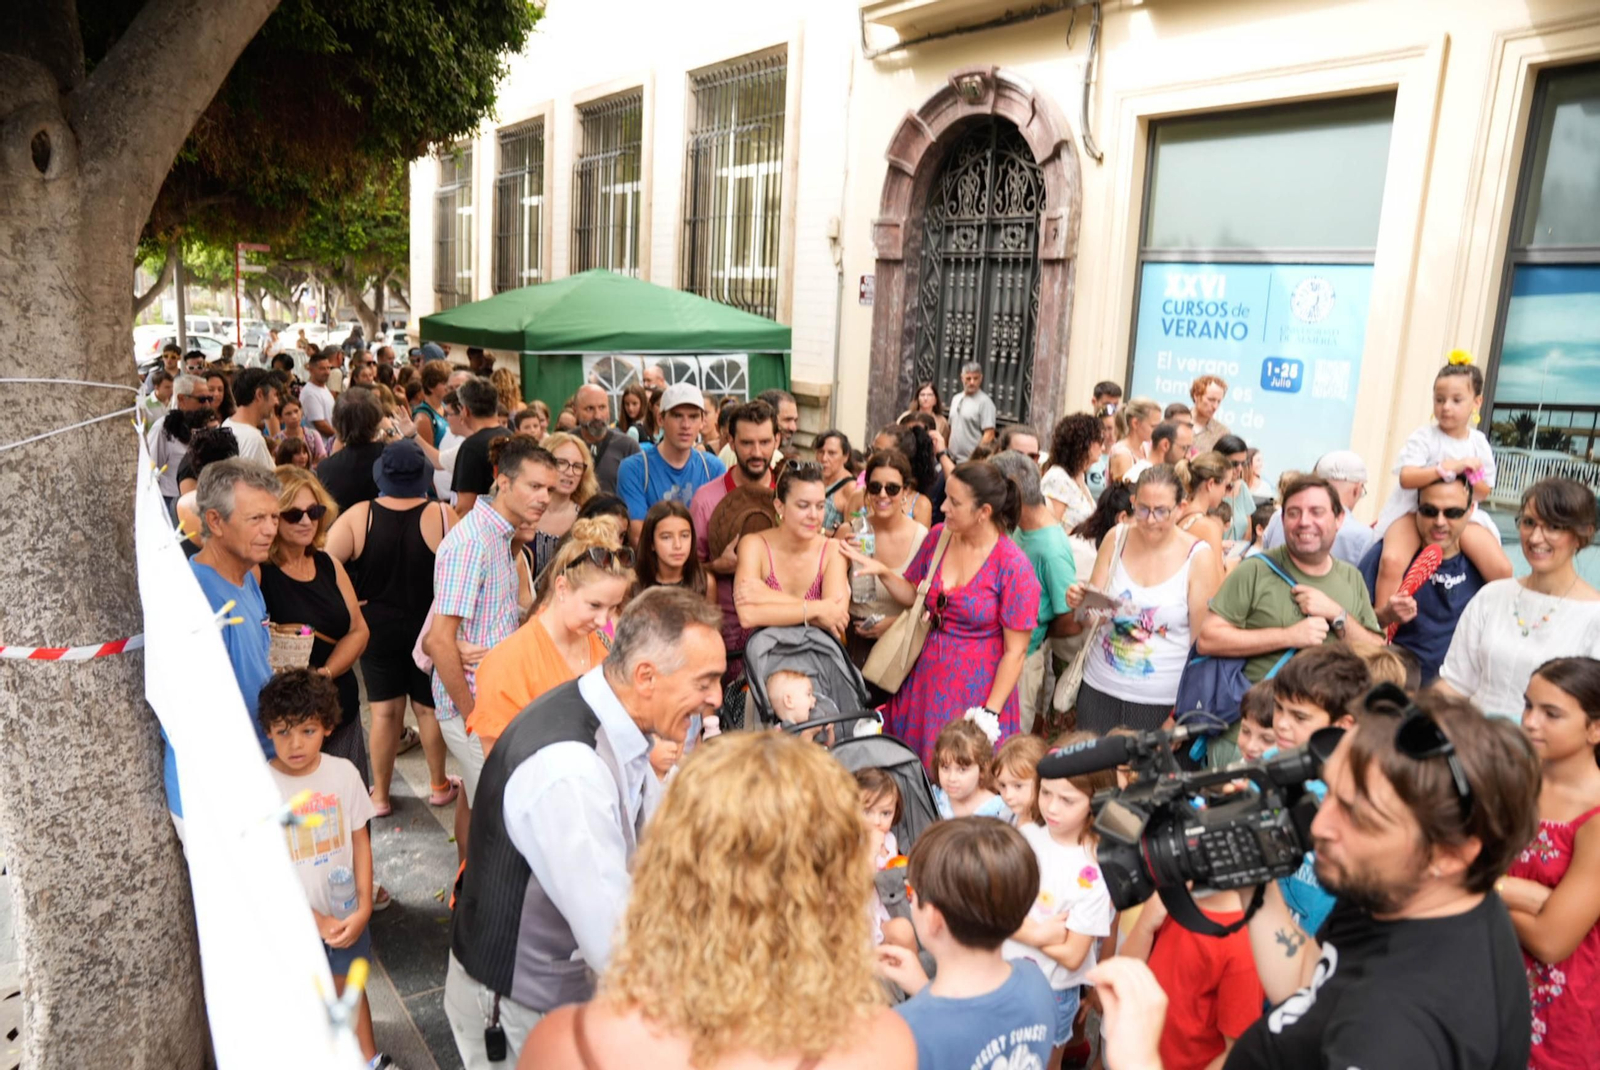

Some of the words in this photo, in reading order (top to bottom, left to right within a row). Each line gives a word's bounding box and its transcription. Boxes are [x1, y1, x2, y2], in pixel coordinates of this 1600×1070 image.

[1164, 274, 1226, 299] XXVI
[1162, 300, 1228, 317] CURSOS
[1231, 302, 1250, 318] de
[1162, 317, 1249, 341] VERANO
[1157, 350, 1172, 370] El
[1177, 357, 1240, 376] verano
[1270, 376, 1292, 389] Julio
[1232, 386, 1253, 403] es
[1240, 407, 1265, 429] de
